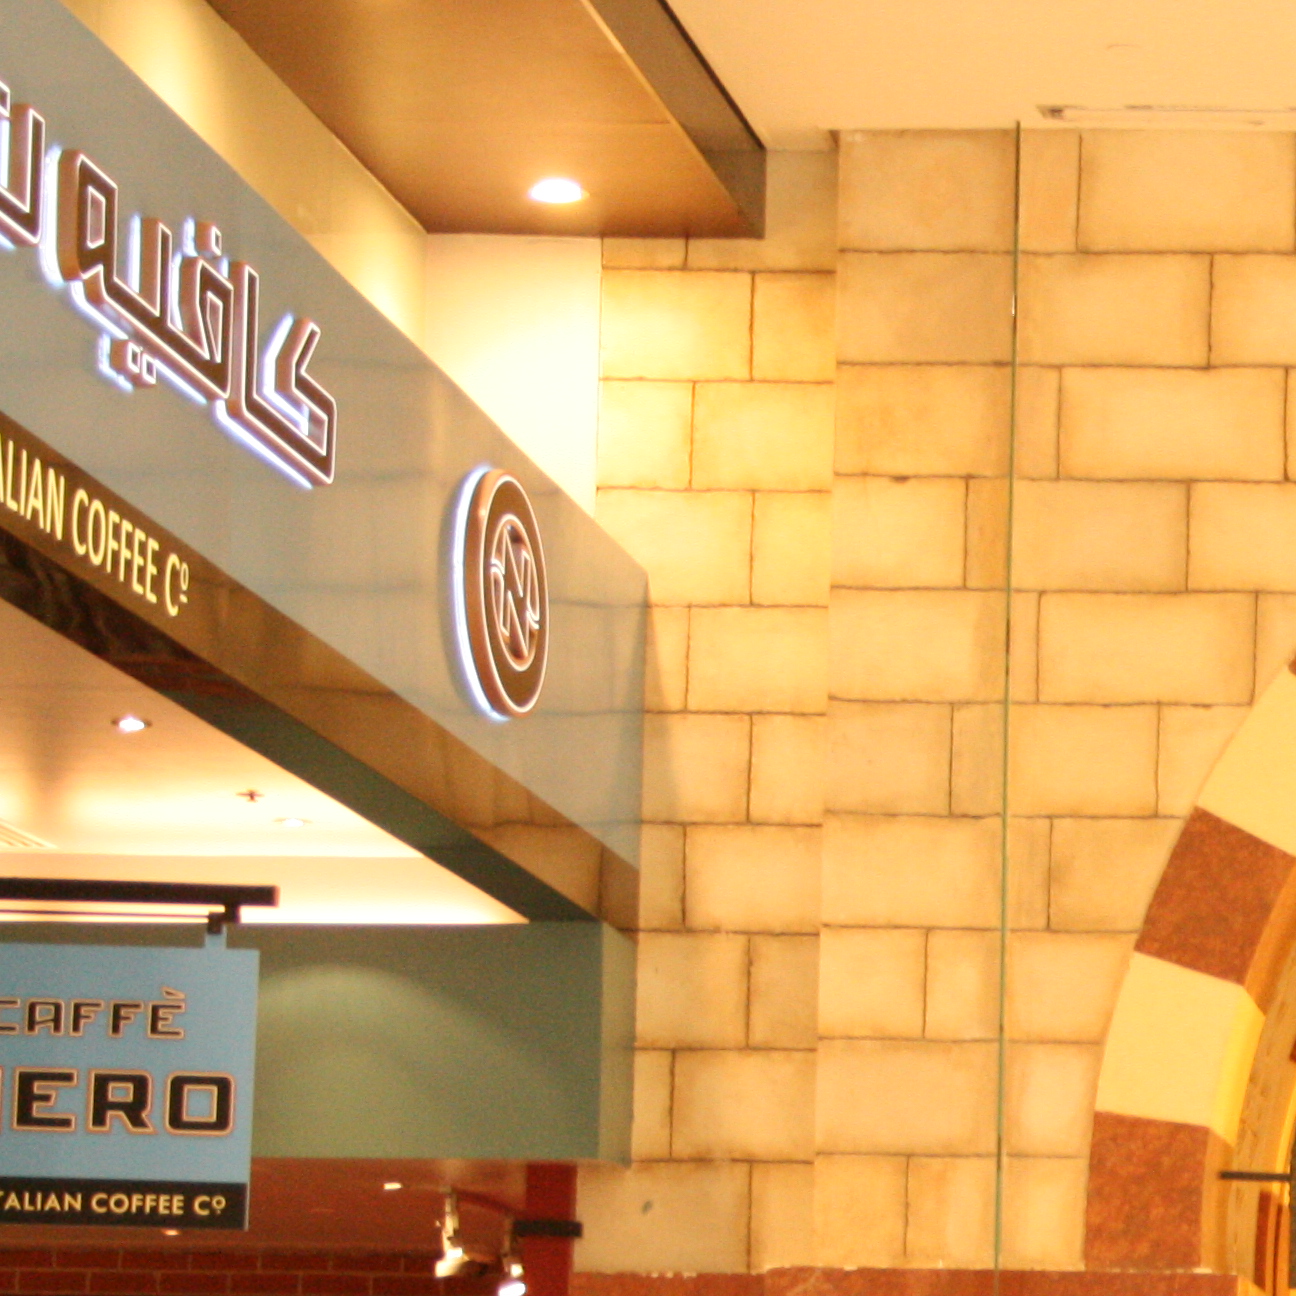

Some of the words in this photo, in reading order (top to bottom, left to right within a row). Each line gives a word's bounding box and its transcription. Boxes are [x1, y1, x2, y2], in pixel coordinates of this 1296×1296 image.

[72, 487, 160, 605] COFFEE
[0, 1066, 236, 1137] ERO
[90, 1192, 184, 1216] COFFEE
